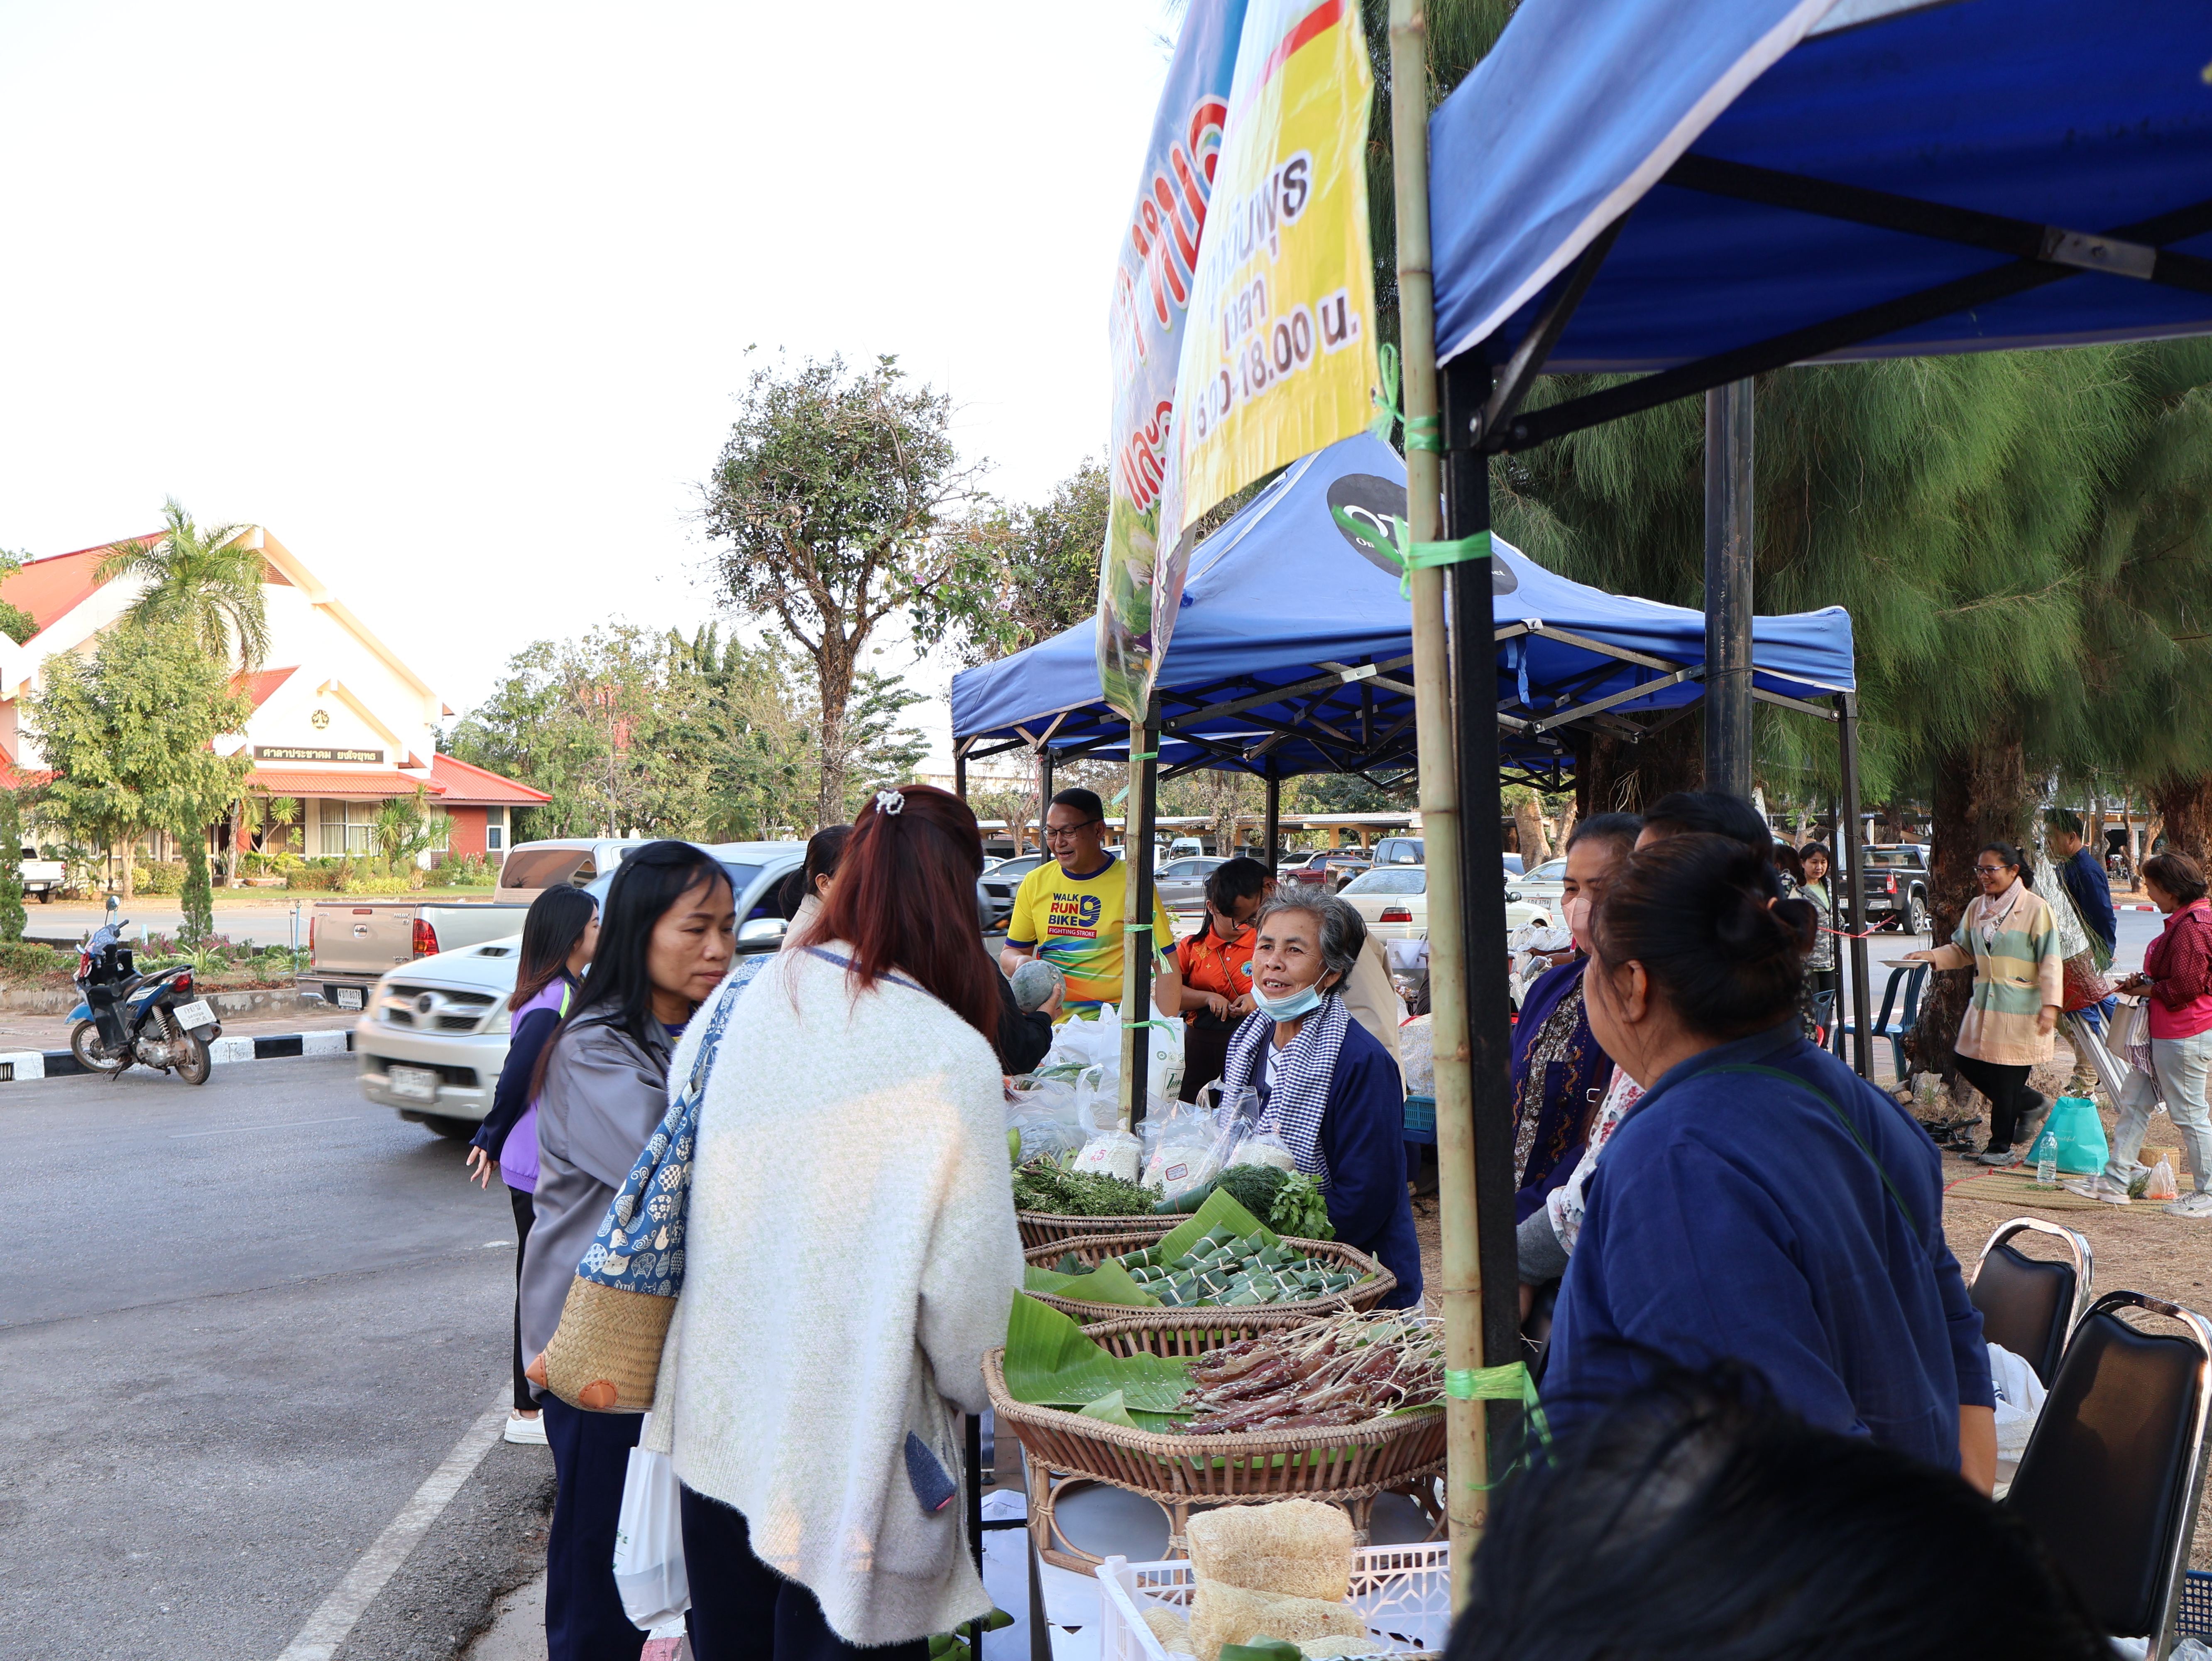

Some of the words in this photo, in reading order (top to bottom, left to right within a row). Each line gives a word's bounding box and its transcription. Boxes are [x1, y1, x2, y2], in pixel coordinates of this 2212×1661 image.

[1223, 279, 1266, 351] เวลา
[1321, 296, 1357, 346] น.
[263, 748, 331, 759] ศาลาประชาคม
[1053, 893, 1079, 902] WALK
[1050, 902, 1079, 914] RUN
[1079, 895, 1101, 927] 9
[1048, 915, 1078, 926] BIKE
